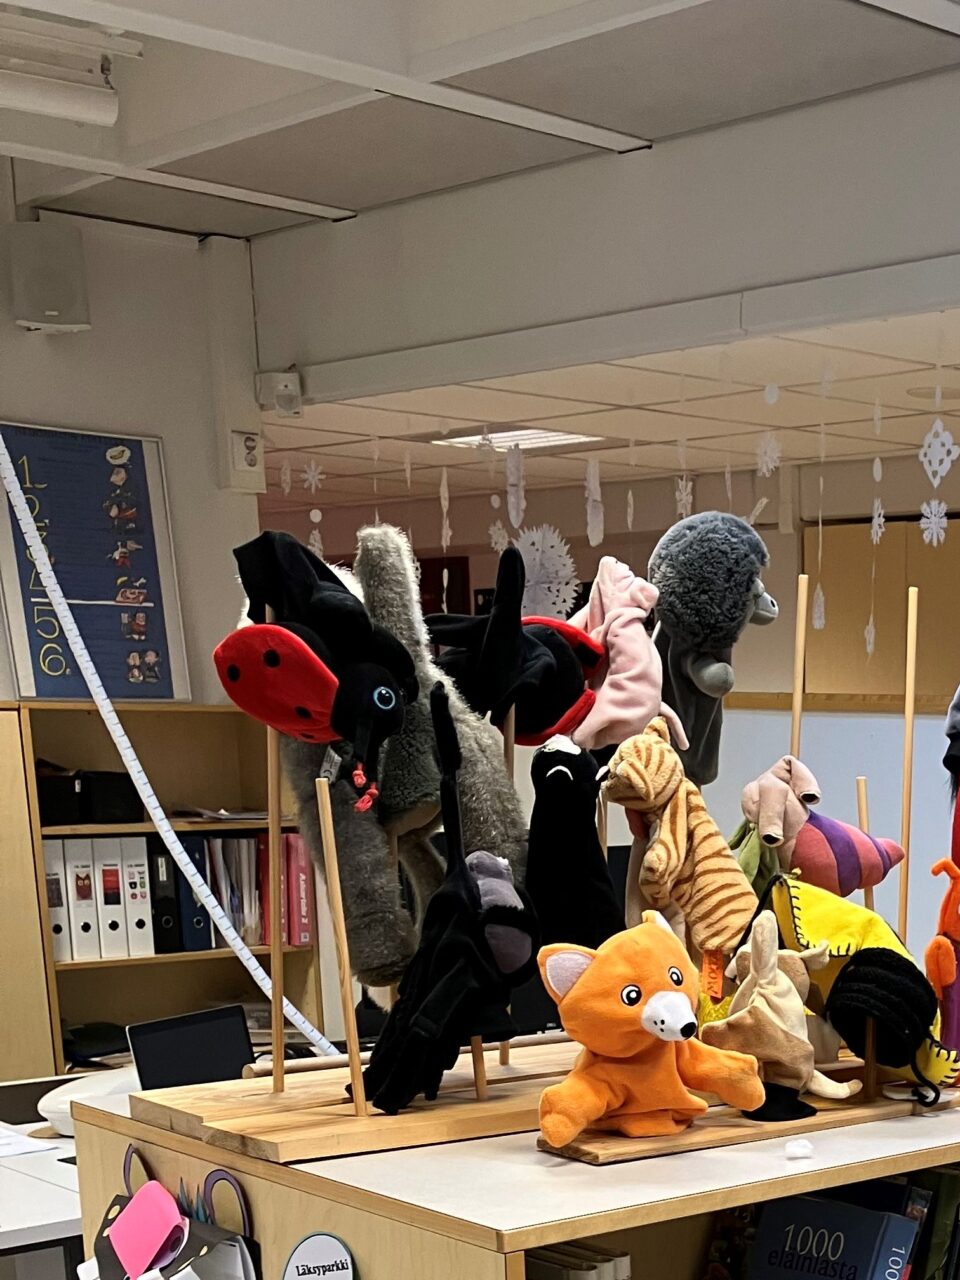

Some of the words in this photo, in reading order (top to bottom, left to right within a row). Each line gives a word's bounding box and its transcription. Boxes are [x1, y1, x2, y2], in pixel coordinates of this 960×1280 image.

[34, 607, 59, 639] 5
[784, 1223, 845, 1261] 1000
[296, 1259, 349, 1276] Läksyparkki
